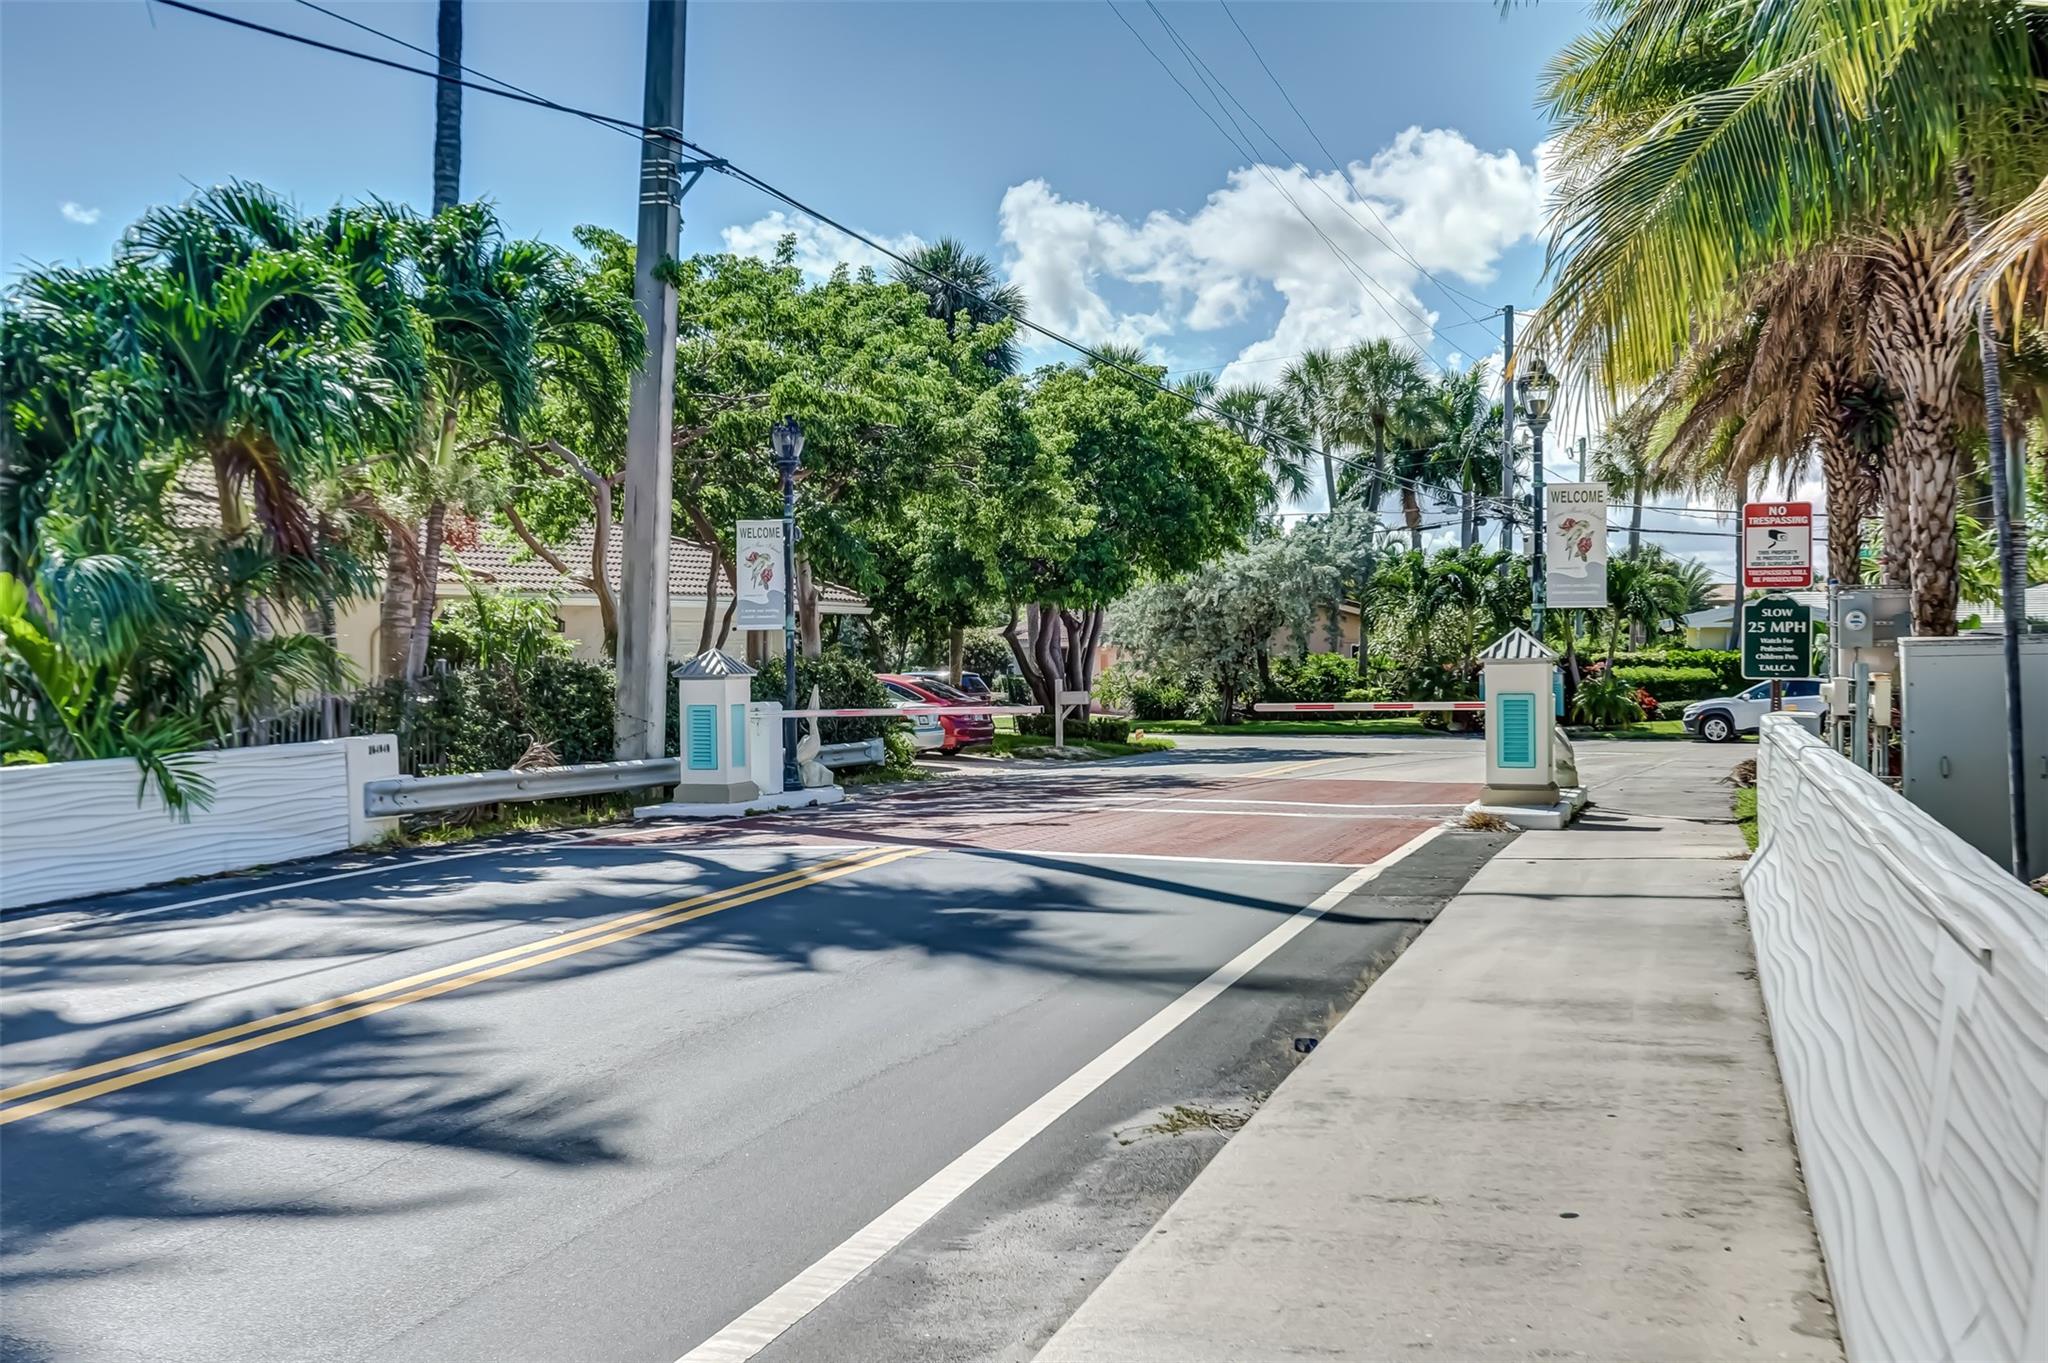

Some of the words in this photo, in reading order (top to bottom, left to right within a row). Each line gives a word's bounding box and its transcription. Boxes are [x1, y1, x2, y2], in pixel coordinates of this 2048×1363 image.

[1551, 490, 1604, 503] WELCOME
[1768, 506, 1787, 516] NO
[1748, 516, 1808, 525] TRESPASSING
[740, 527, 780, 538] WELCOME
[1761, 608, 1793, 617] SLOW
[1748, 621, 1766, 633] 25
[1770, 621, 1806, 633] MPH
